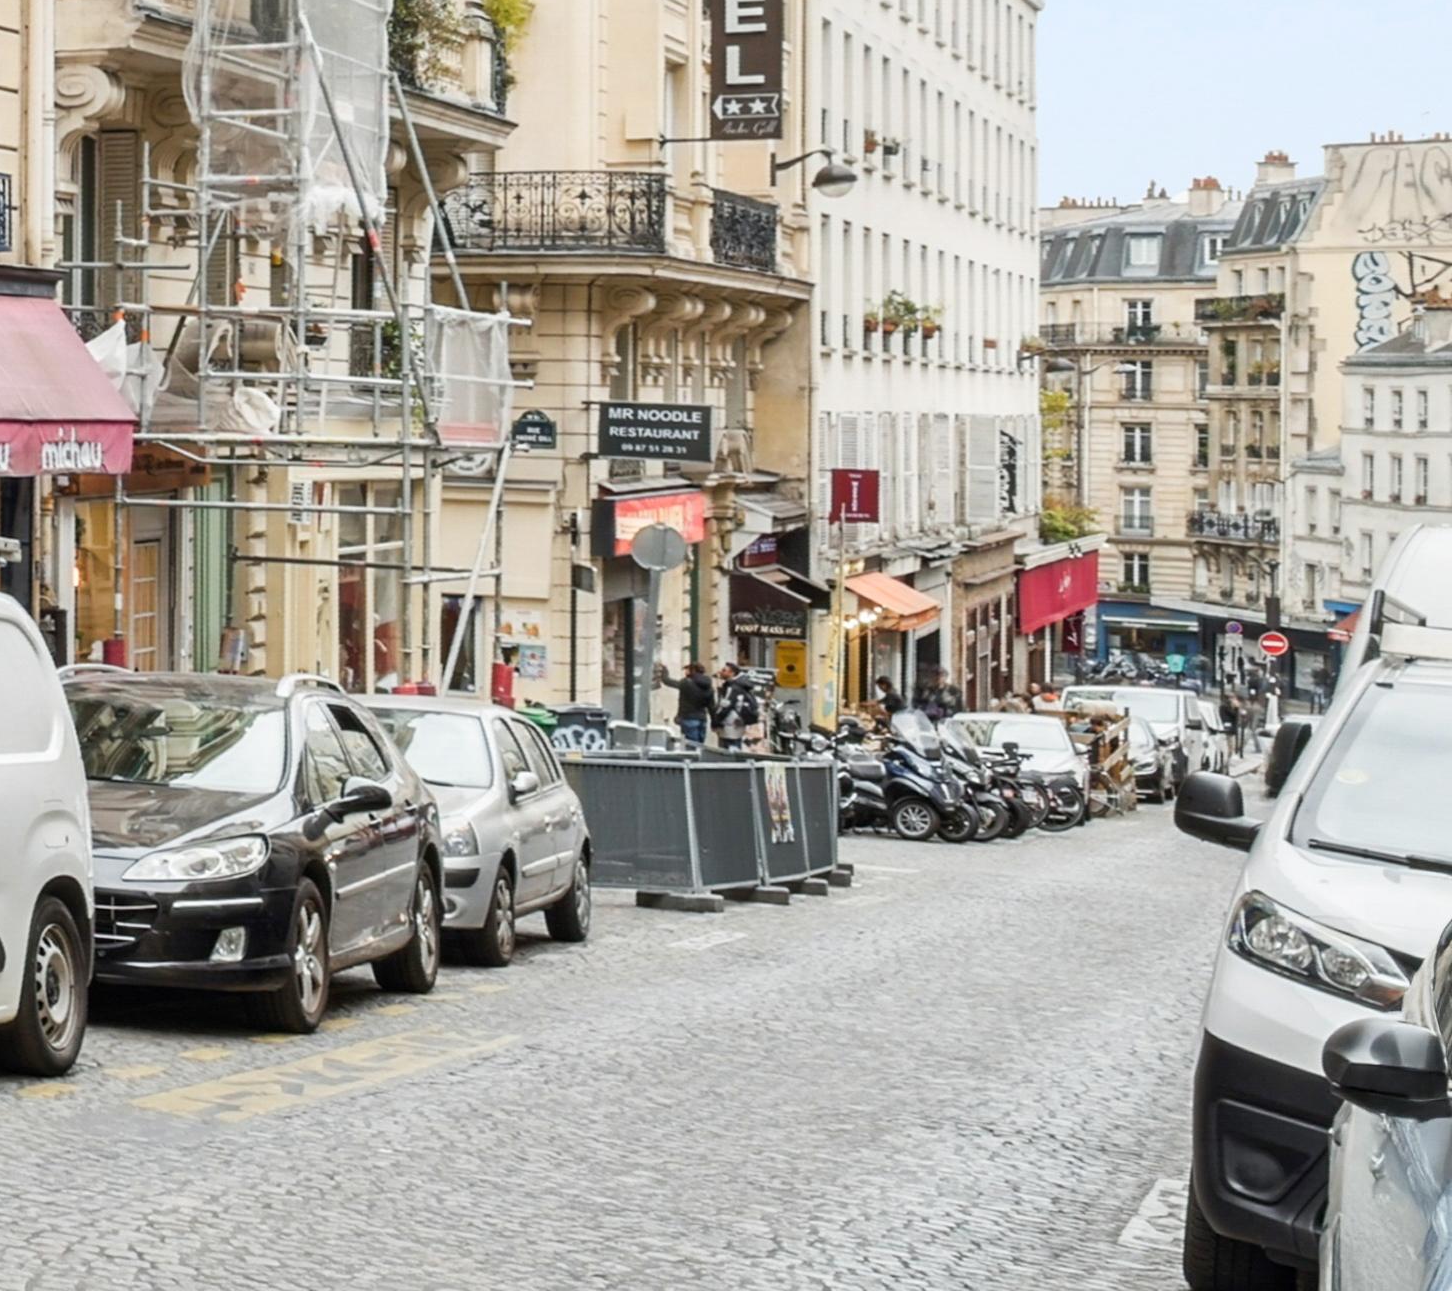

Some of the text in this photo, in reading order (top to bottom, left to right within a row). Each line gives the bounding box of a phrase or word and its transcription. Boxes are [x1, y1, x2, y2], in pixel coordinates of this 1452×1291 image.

[607, 407, 703, 423] MR NOODLE
[609, 425, 701, 441] RESTAURANT
[41, 426, 104, 471] michou
